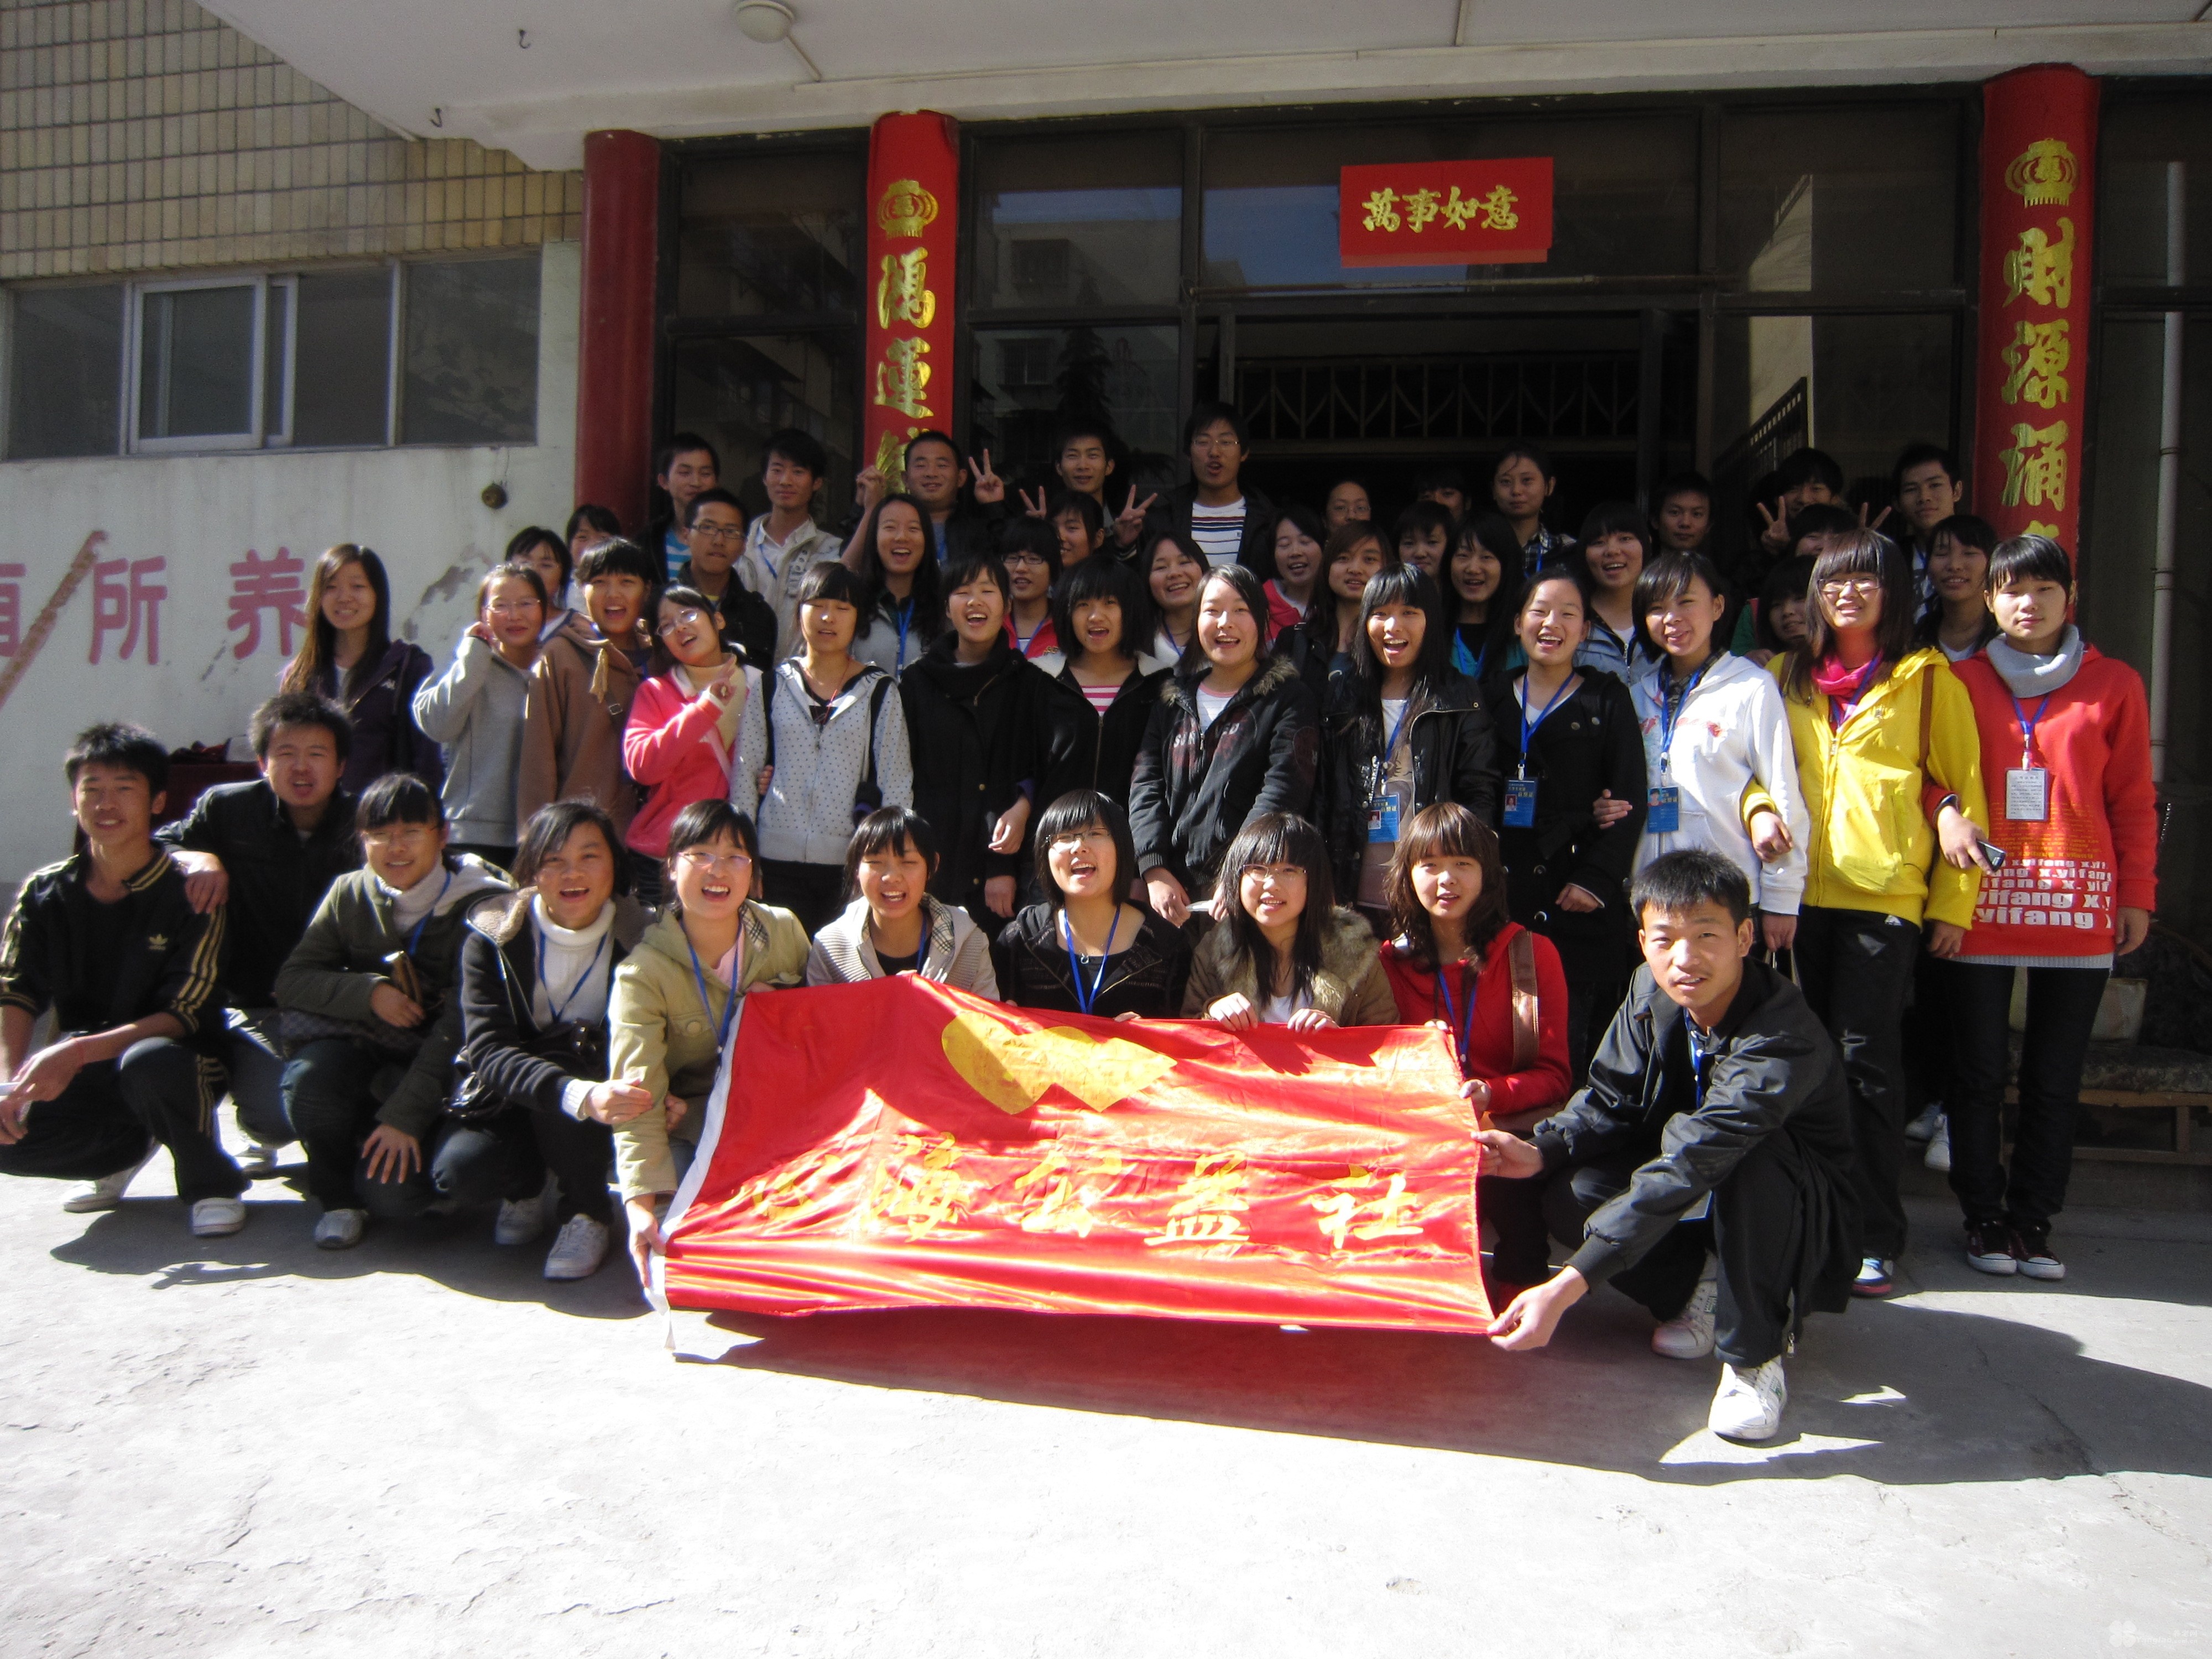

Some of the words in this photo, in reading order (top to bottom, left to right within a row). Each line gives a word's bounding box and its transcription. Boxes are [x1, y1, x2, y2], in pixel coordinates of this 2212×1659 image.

[1361, 185, 1519, 233] 萬事如意
[1999, 217, 2074, 540] 財源涌
